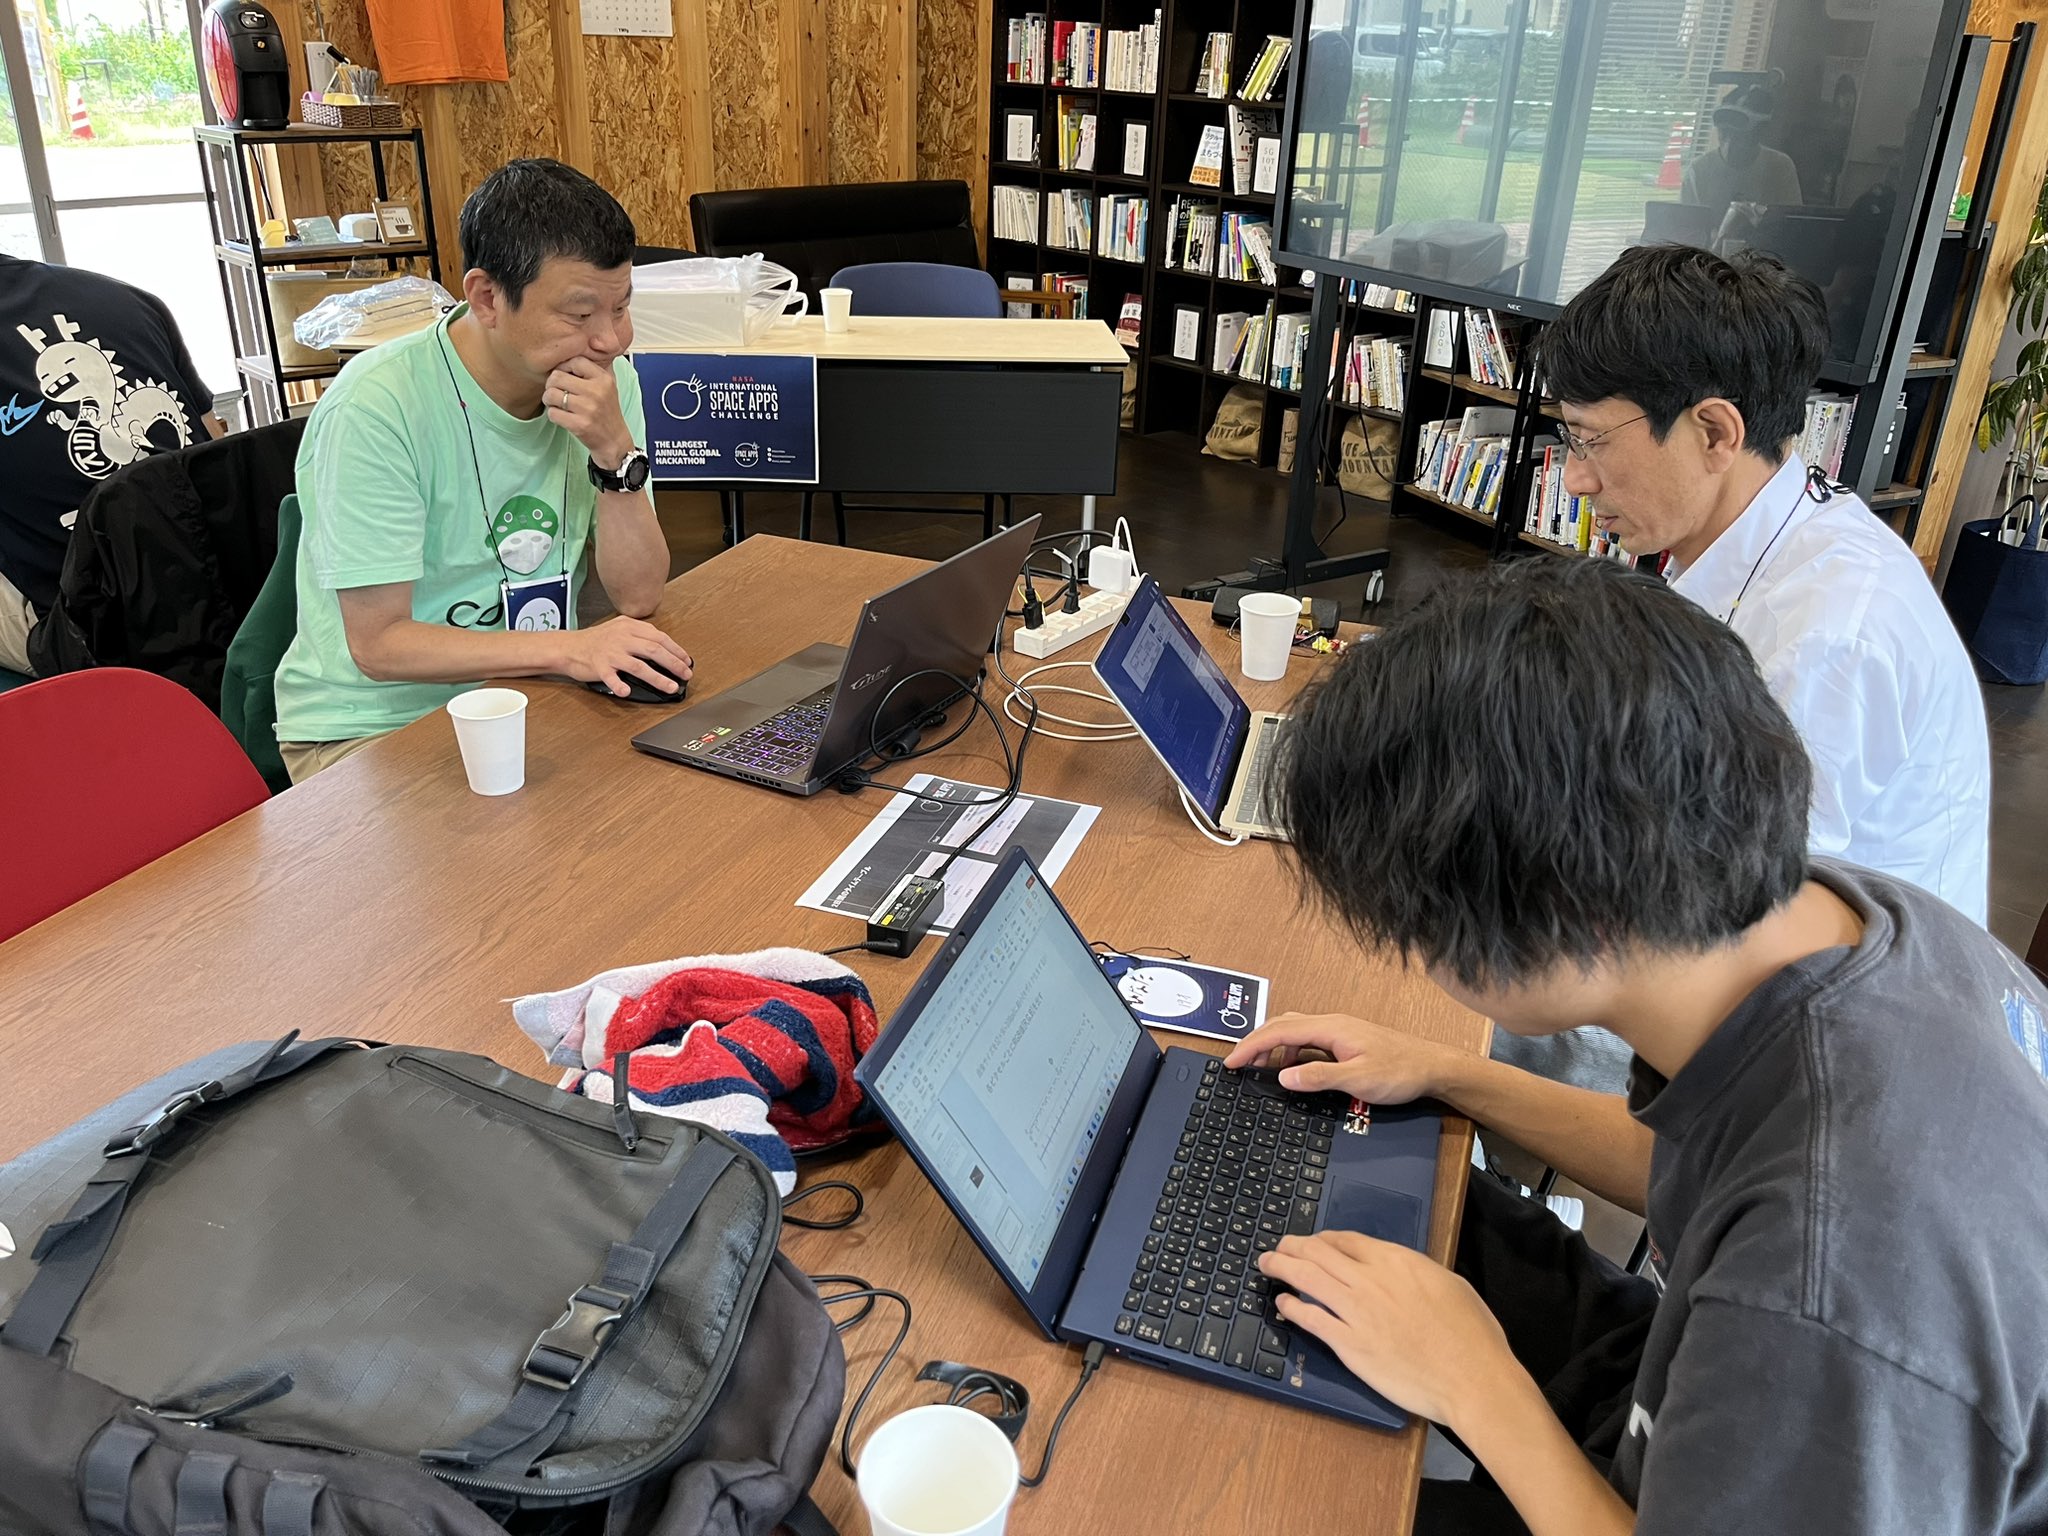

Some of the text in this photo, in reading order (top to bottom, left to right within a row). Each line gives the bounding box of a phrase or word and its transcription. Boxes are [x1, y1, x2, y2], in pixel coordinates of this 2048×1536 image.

[1507, 303, 1522, 312] NEC
[709, 382, 777, 392] INTERNATIONAL
[709, 391, 779, 412] SPACE APPS
[710, 411, 779, 421] CHALLENGE
[654, 440, 708, 449] THE LARGEST
[655, 448, 721, 457] ANNUAL GLOBAL
[655, 457, 706, 465] HACKATHON
